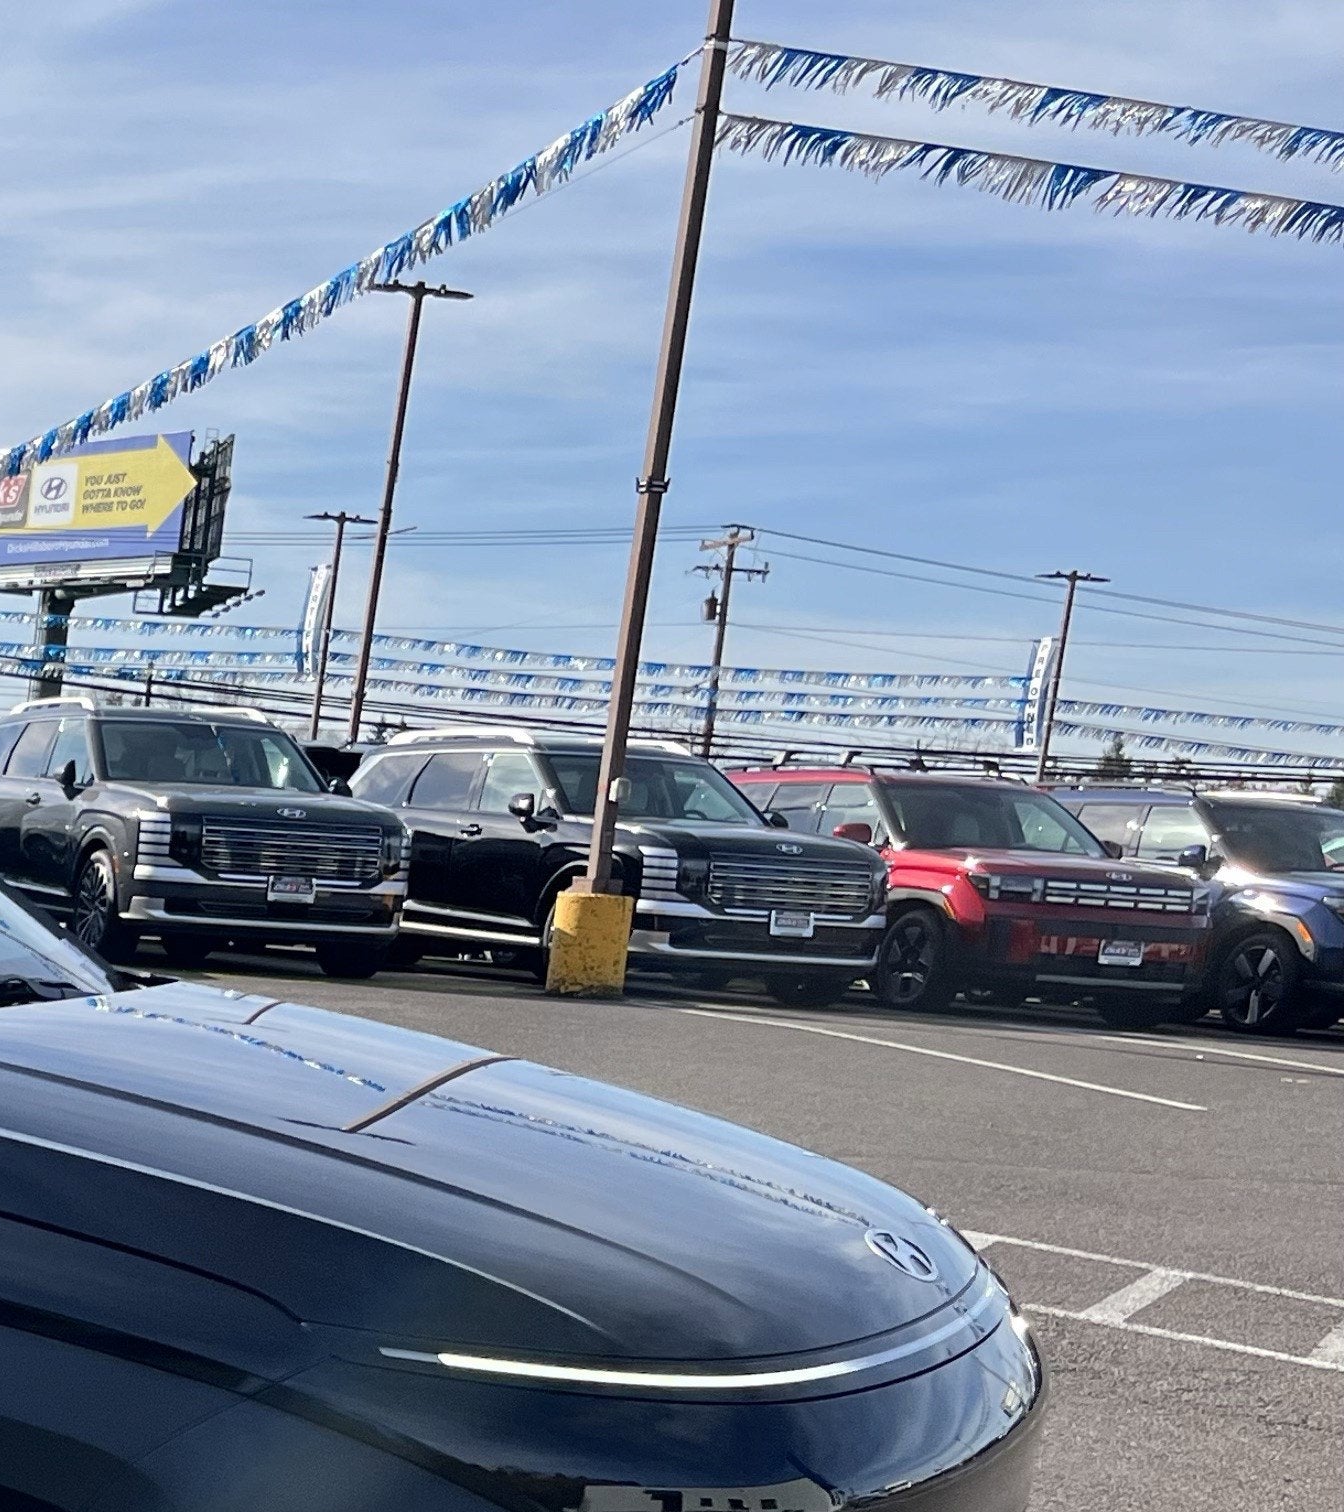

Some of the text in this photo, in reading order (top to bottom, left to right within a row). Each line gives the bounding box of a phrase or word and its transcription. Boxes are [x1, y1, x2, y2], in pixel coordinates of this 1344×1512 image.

[85, 473, 127, 486] YOU JUST
[83, 485, 143, 500] GOTTA KNOW
[34, 503, 70, 514] HYUNDAI
[82, 501, 114, 514] WHERE
[116, 500, 128, 511] TO
